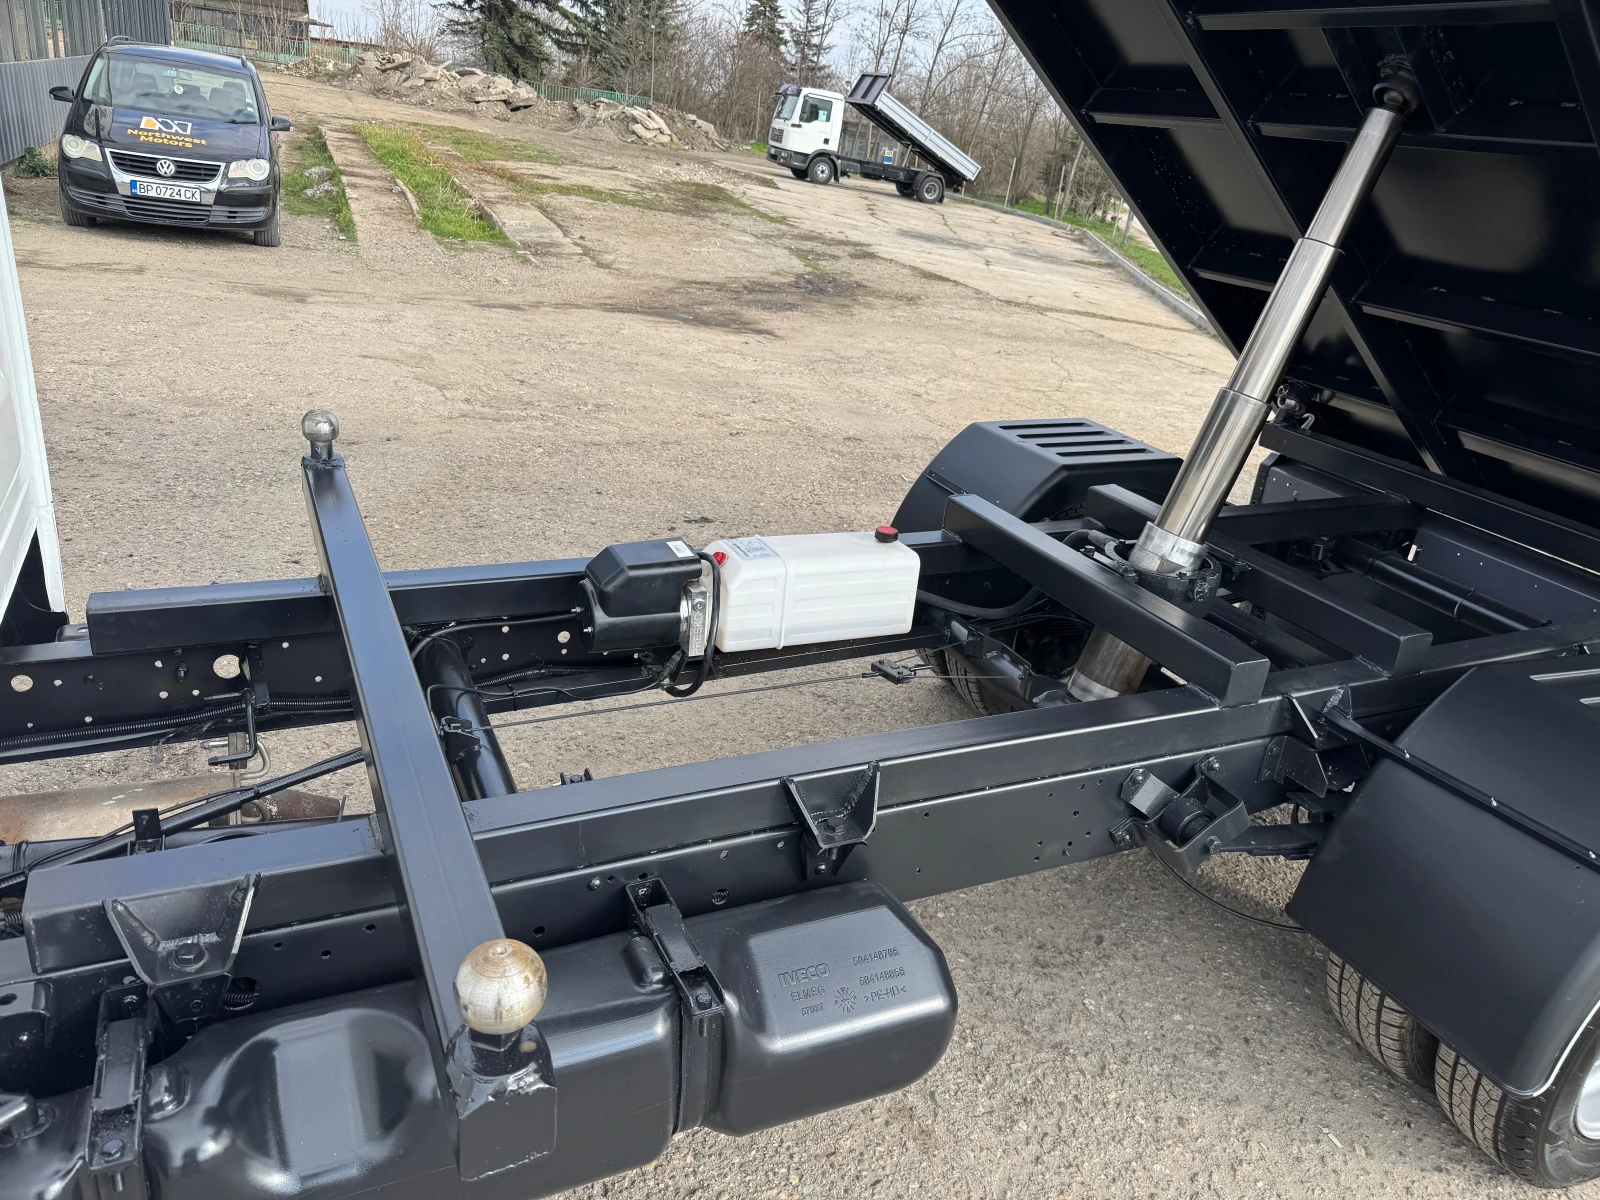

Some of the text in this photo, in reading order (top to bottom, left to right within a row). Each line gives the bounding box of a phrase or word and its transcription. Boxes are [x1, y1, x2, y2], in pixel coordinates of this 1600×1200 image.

[127, 129, 207, 145] Northwest
[140, 136, 193, 148] Motors
[155, 186, 182, 198] 0724
[778, 963, 830, 987] IVECO
